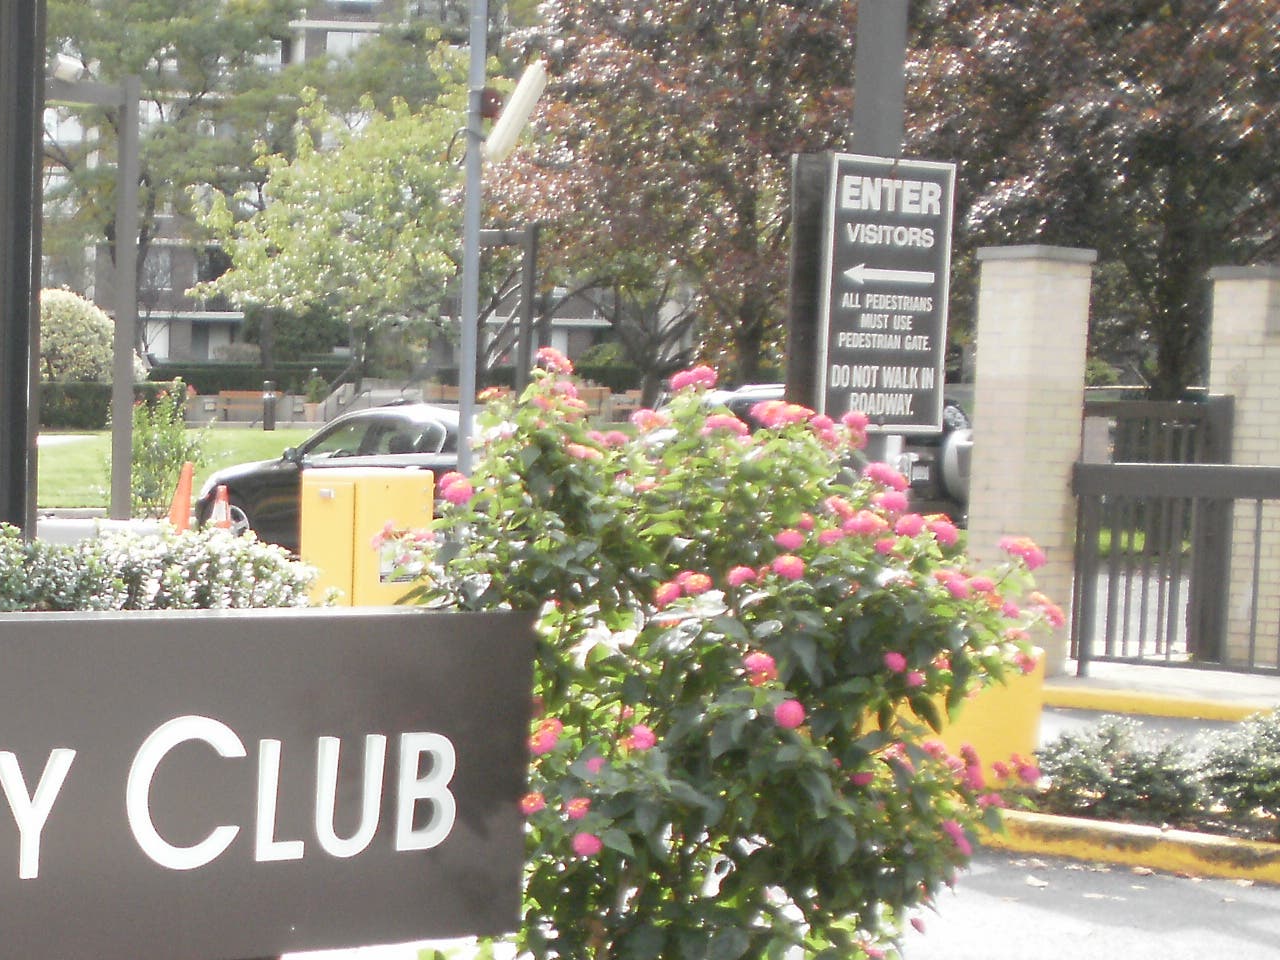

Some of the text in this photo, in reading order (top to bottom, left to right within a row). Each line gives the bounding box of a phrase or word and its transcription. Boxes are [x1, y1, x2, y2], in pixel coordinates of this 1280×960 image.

[841, 175, 942, 215] ENTER
[847, 222, 935, 248] VISITORS
[842, 292, 933, 312] ALL PEDESTRIANS
[861, 313, 913, 330] MUST USE
[839, 332, 932, 351] PEDESTRIAN GATE.
[831, 364, 935, 389] DO NOT WALK IN
[850, 392, 914, 415] ROADWAY.
[126, 715, 457, 870] CLUB
